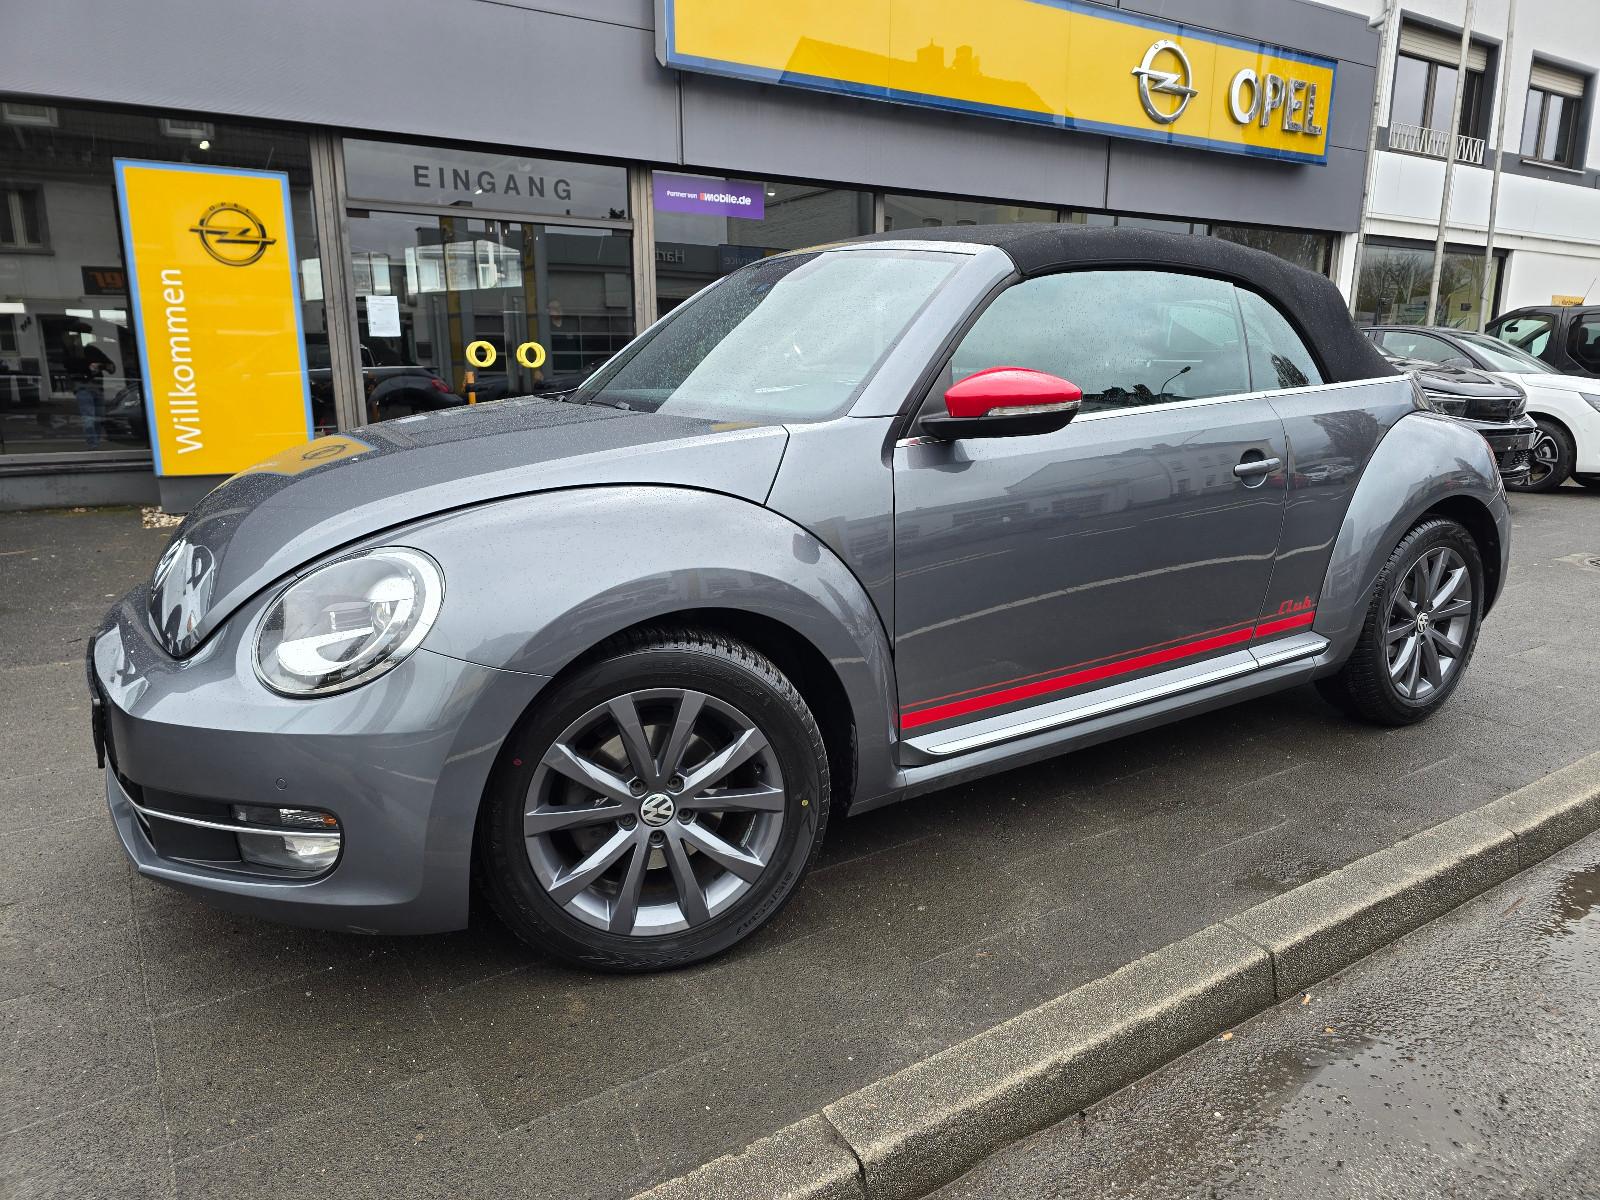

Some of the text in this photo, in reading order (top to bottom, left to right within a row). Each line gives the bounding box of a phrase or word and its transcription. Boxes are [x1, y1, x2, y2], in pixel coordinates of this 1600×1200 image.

[1228, 68, 1322, 135] OPEL
[413, 165, 572, 200] EINGANG
[666, 190, 686, 199] Partner
[704, 192, 752, 206] mobile.de
[161, 269, 204, 454] Willkommen
[1277, 595, 1312, 615] Club
